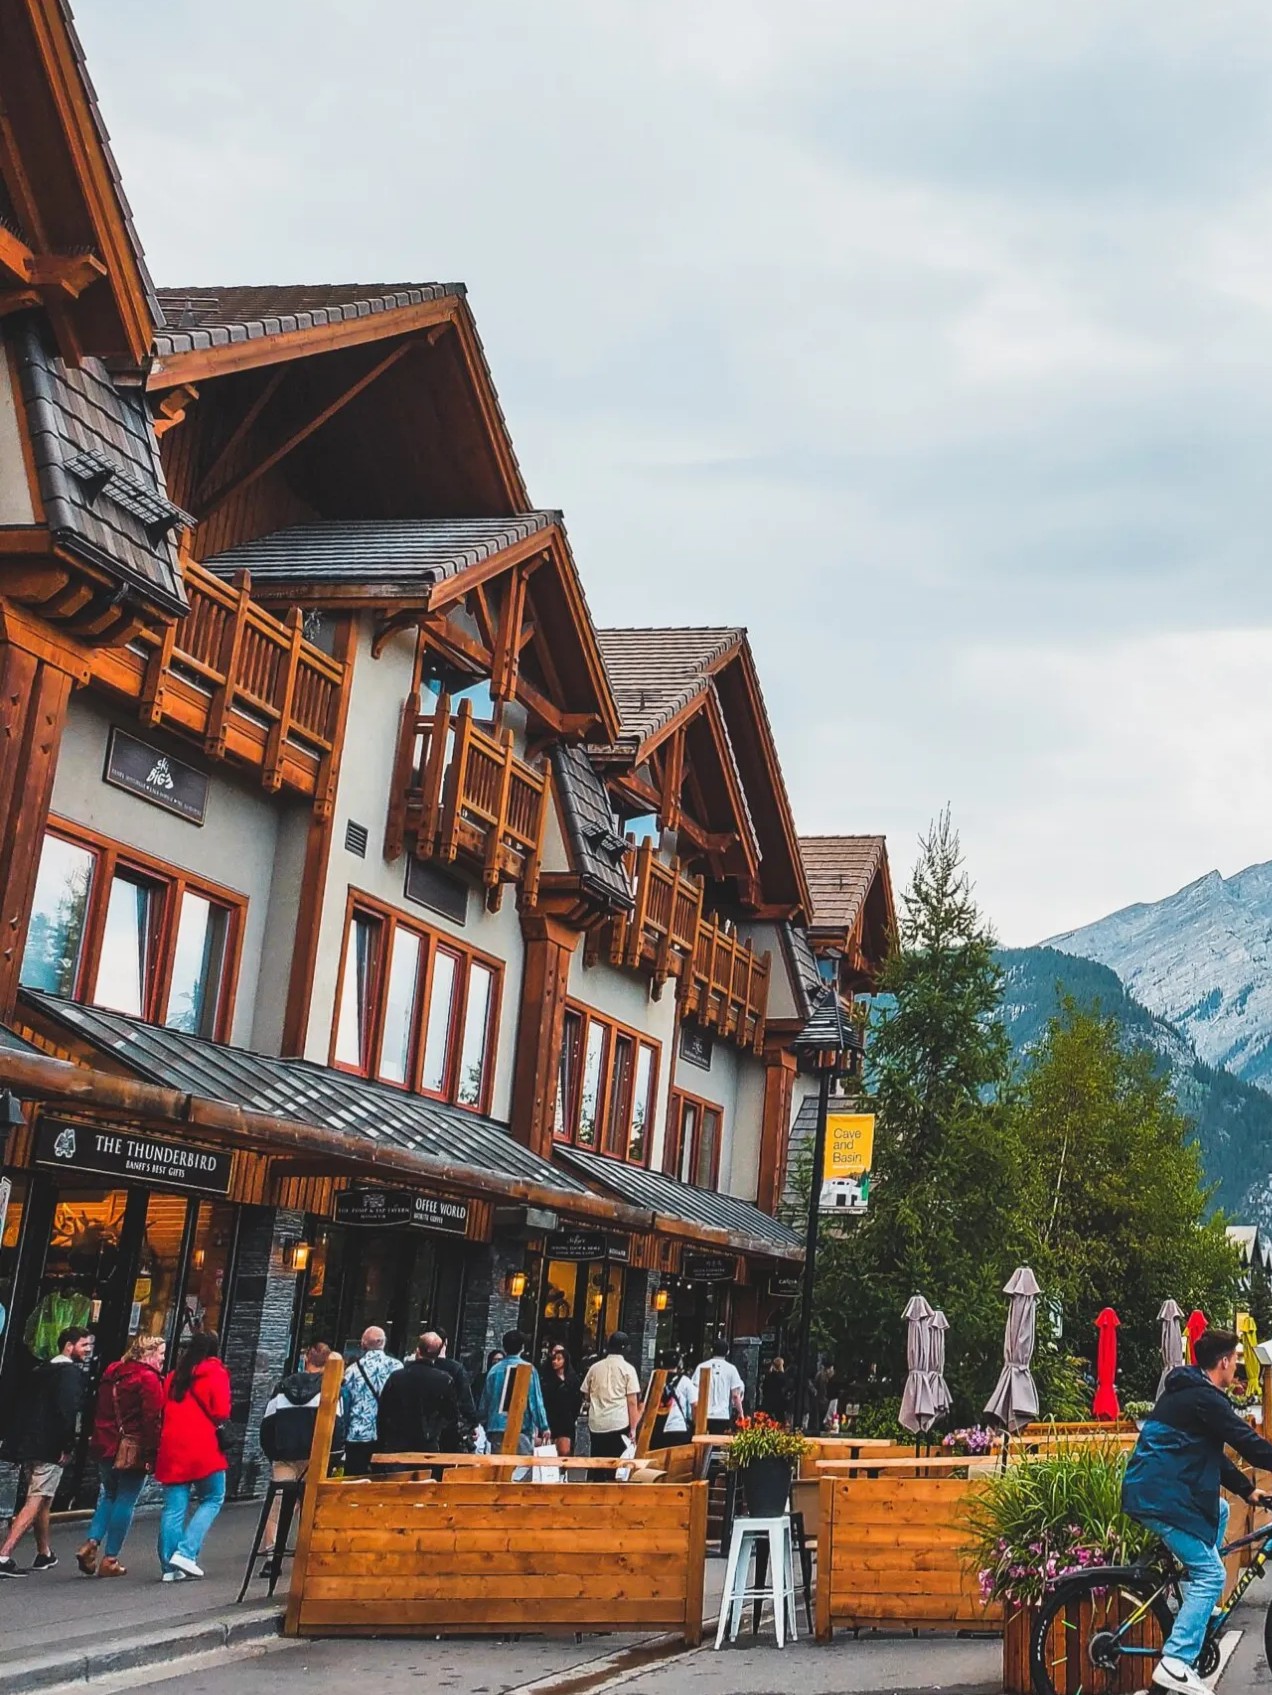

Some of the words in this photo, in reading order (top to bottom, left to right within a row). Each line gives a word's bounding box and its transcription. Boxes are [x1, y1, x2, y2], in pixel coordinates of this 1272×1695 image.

[833, 1128, 862, 1139] Cave
[833, 1140, 854, 1150] and
[95, 1135, 122, 1155] THE
[127, 1140, 217, 1171] THUNDERBIRD
[832, 1152, 862, 1163] Basin
[125, 1160, 151, 1172] BANFF'S
[151, 1164, 167, 1175] BEST
[168, 1167, 186, 1178] GIFTS
[415, 1197, 437, 1214] OFFEE
[440, 1202, 466, 1219] WORLD
